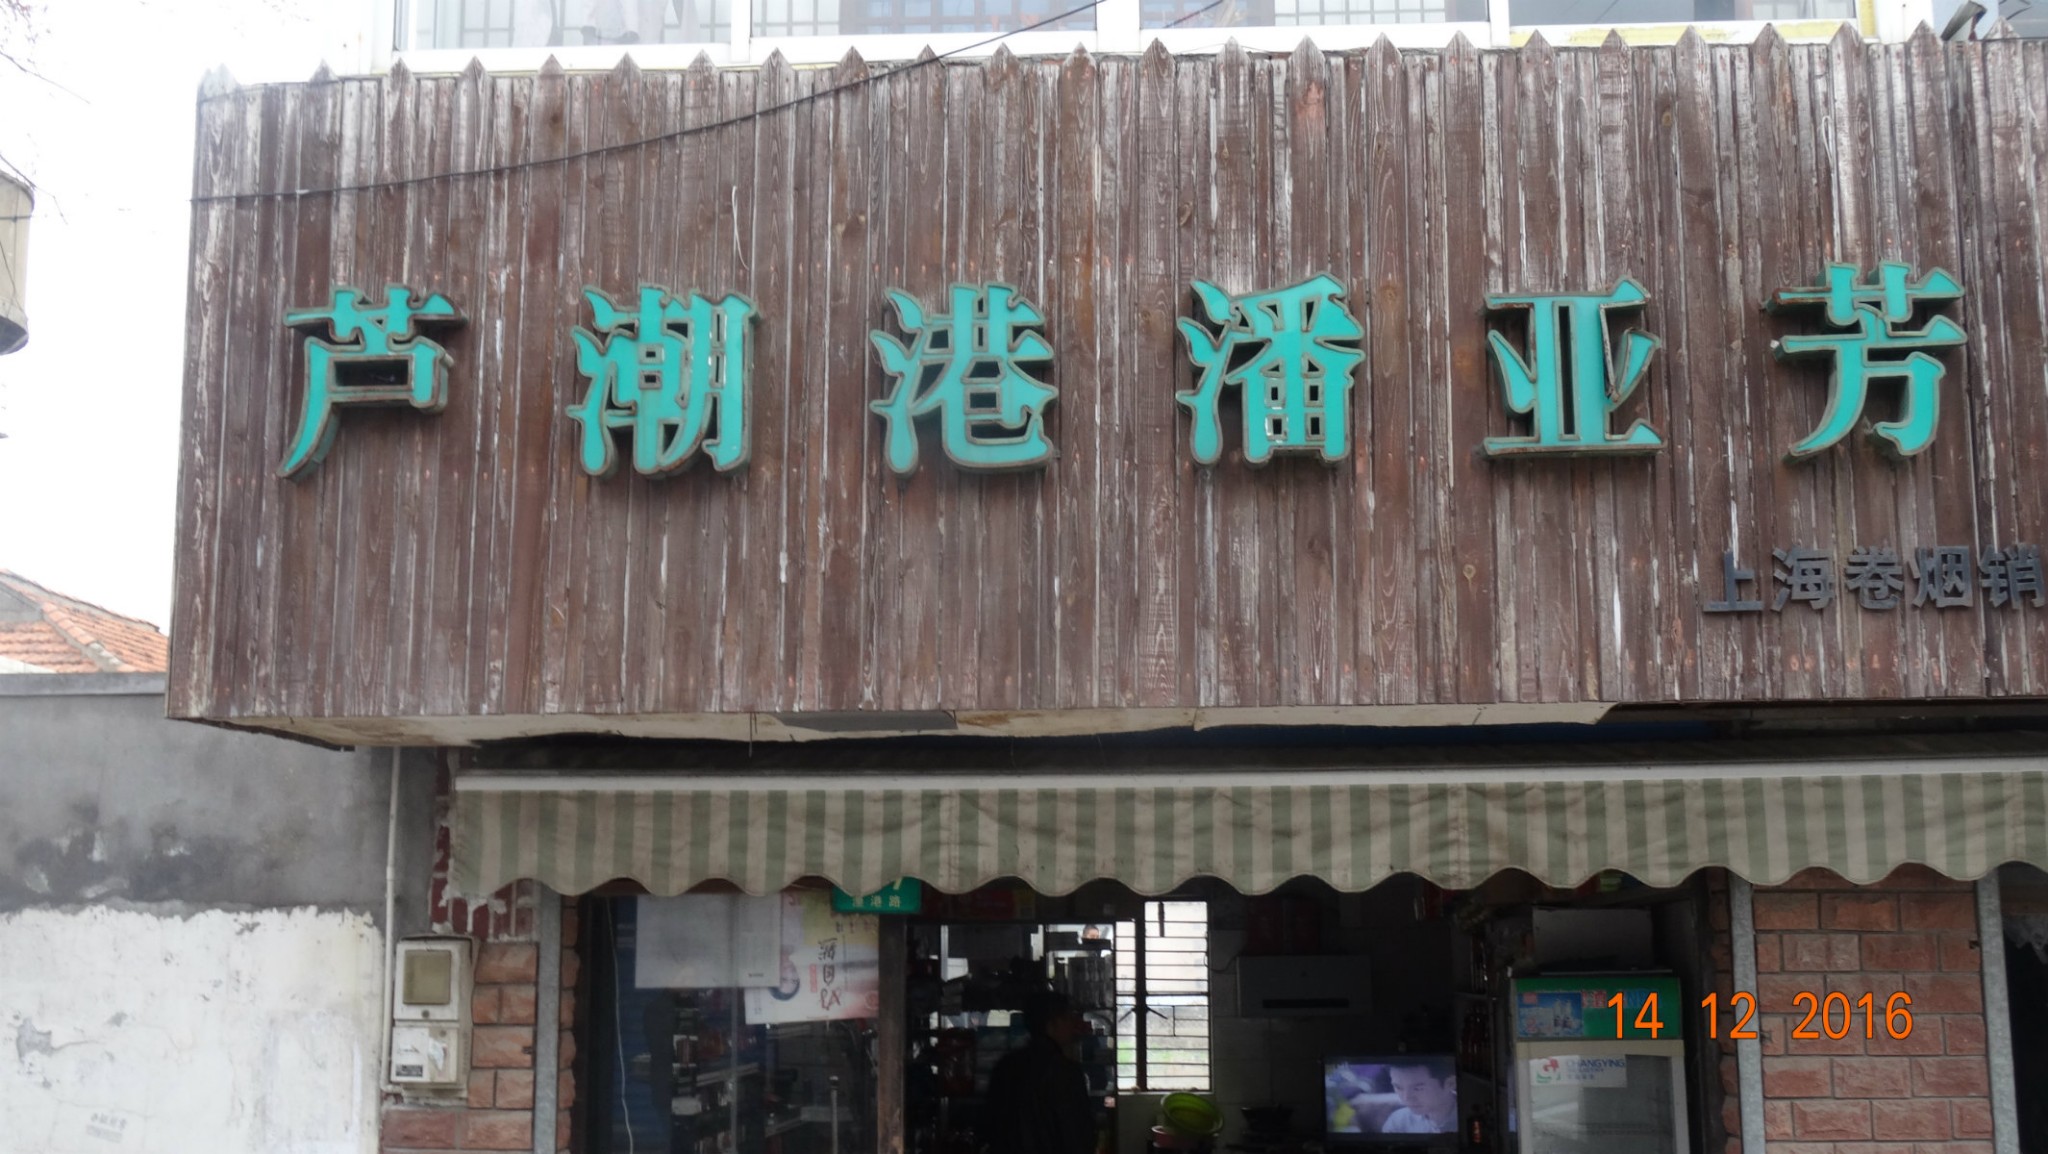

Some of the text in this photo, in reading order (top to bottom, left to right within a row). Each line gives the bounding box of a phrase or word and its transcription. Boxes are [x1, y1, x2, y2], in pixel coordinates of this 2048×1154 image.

[277, 260, 1967, 478] 芦潮港潘亚芳
[1703, 543, 2045, 612] 上海卷烟销
